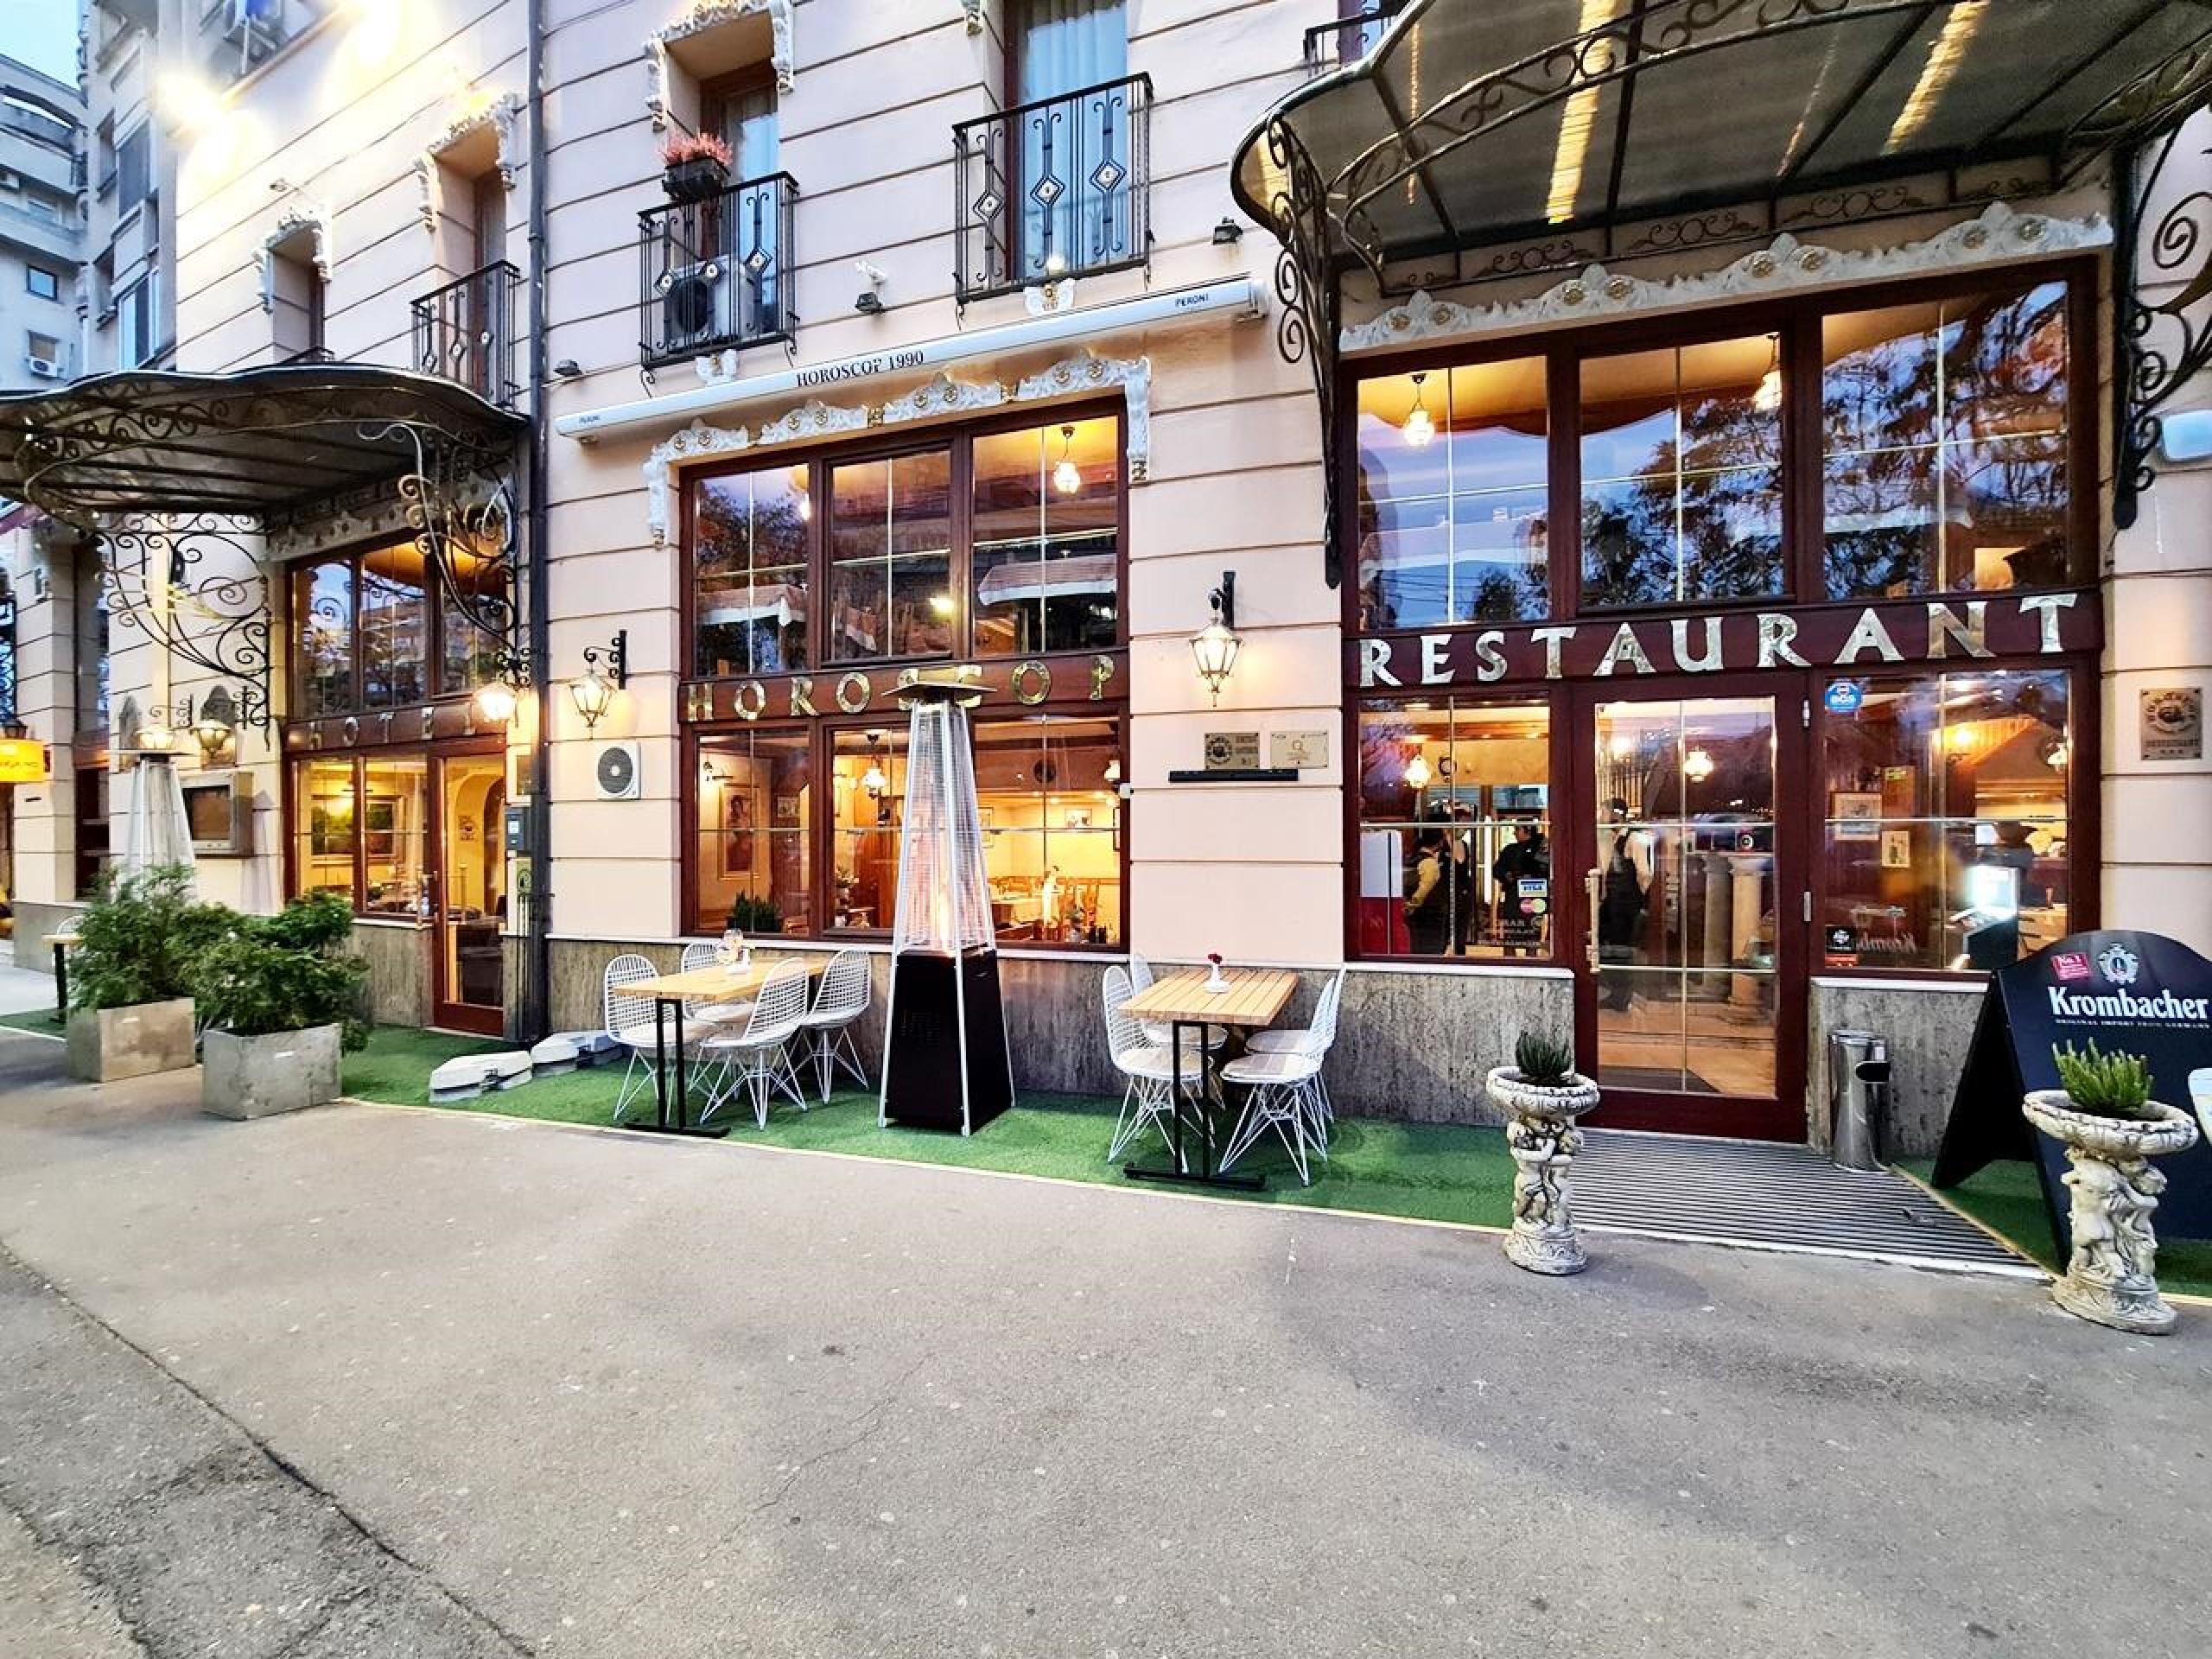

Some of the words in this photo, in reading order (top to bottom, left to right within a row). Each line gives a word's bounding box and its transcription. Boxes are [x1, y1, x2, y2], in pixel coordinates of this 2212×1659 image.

[796, 358, 882, 387] HOROSCOP
[888, 350, 925, 371] 1990
[1359, 594, 2077, 687] RESTAURANT
[2048, 986, 2209, 1019] Krombacher
